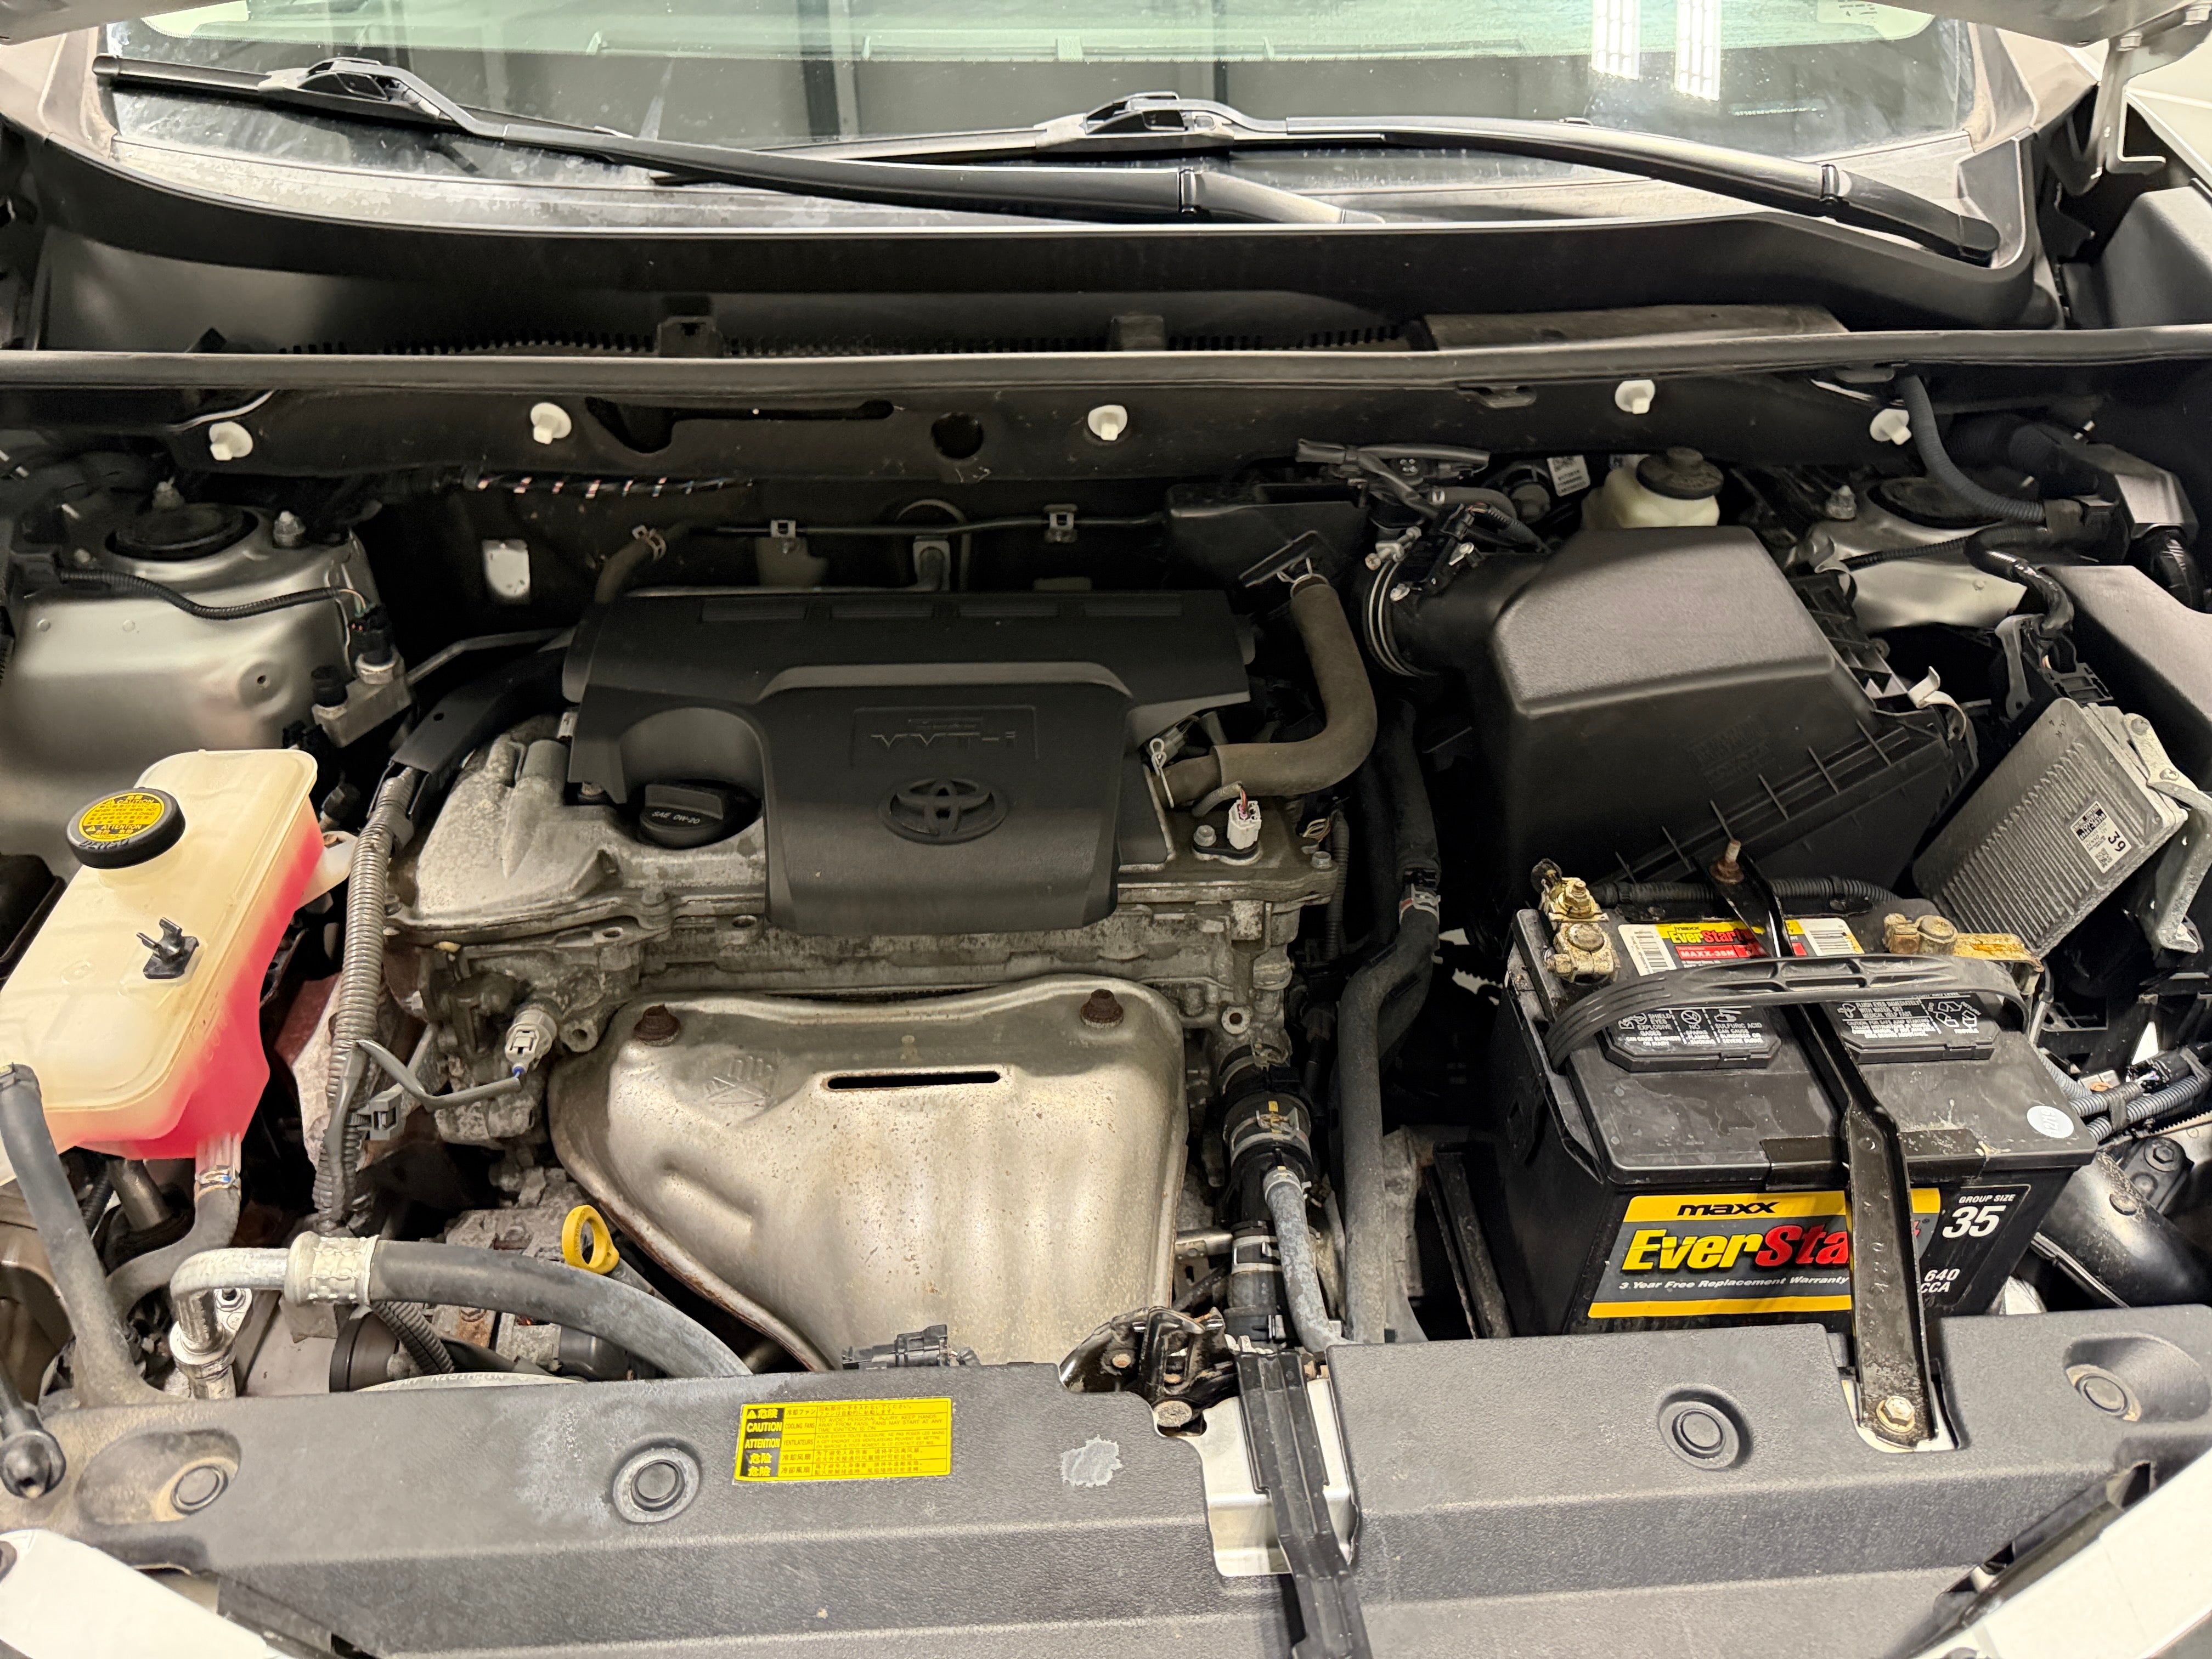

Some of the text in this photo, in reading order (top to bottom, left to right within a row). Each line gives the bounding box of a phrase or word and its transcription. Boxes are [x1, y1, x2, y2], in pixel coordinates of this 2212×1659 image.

[2081, 814, 2099, 832] TOYOTA
[2108, 831, 2126, 852] 39
[1959, 1194, 2016, 1204] GROUP SIZE
[1677, 1201, 1780, 1216] maxx
[1942, 1205, 2006, 1238] 35
[1622, 1221, 1920, 1271] EverSta
[1924, 1268, 1960, 1282] 640
[1632, 1281, 1662, 1289] Year
[1698, 1277, 1786, 1288] Replacement
[1789, 1276, 1850, 1285] Warranty
[1920, 1282, 1951, 1294] CCA
[747, 1422, 782, 1432] CAUTION
[745, 1438, 780, 1449] ATTENTION
